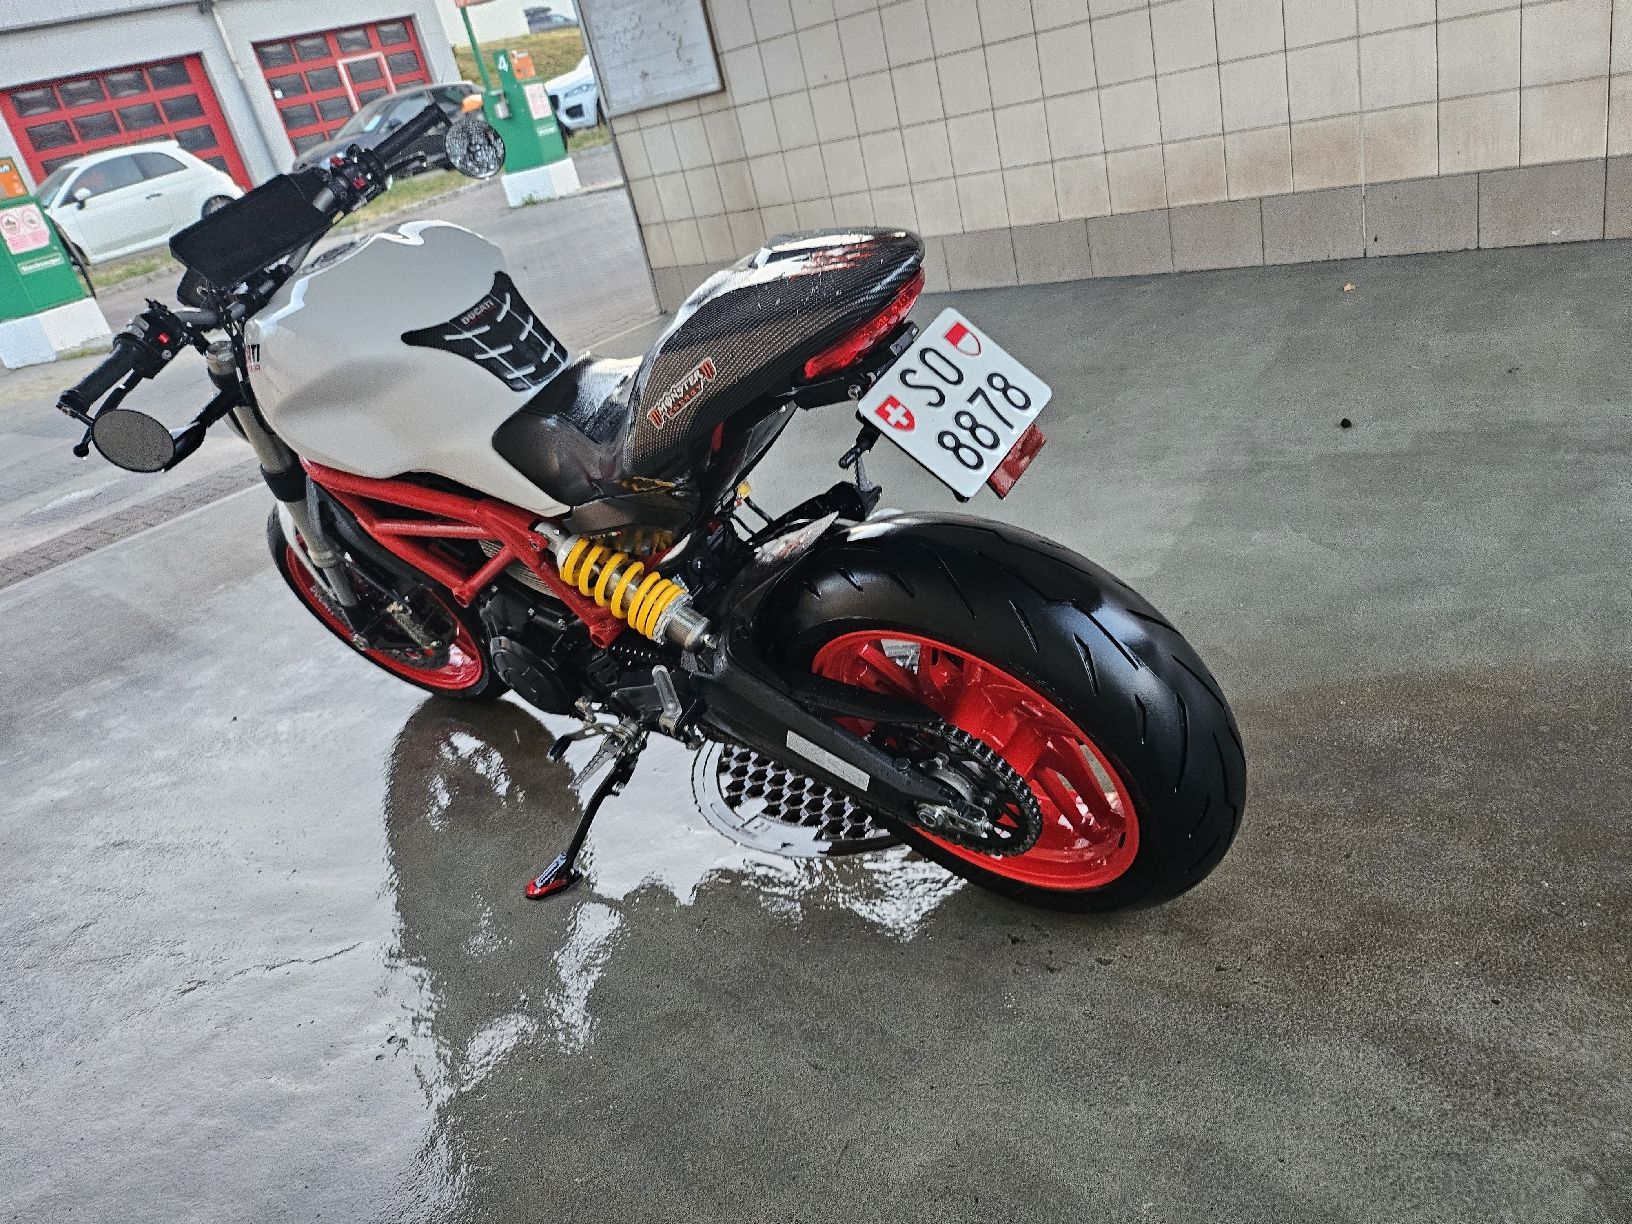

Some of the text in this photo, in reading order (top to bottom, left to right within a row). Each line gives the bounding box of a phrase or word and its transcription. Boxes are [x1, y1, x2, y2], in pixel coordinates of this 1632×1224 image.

[498, 56, 508, 73] 4
[461, 300, 494, 325] DUCATI
[657, 369, 703, 412] MONSTER
[899, 347, 964, 408] SO
[937, 372, 1032, 470] 8878
